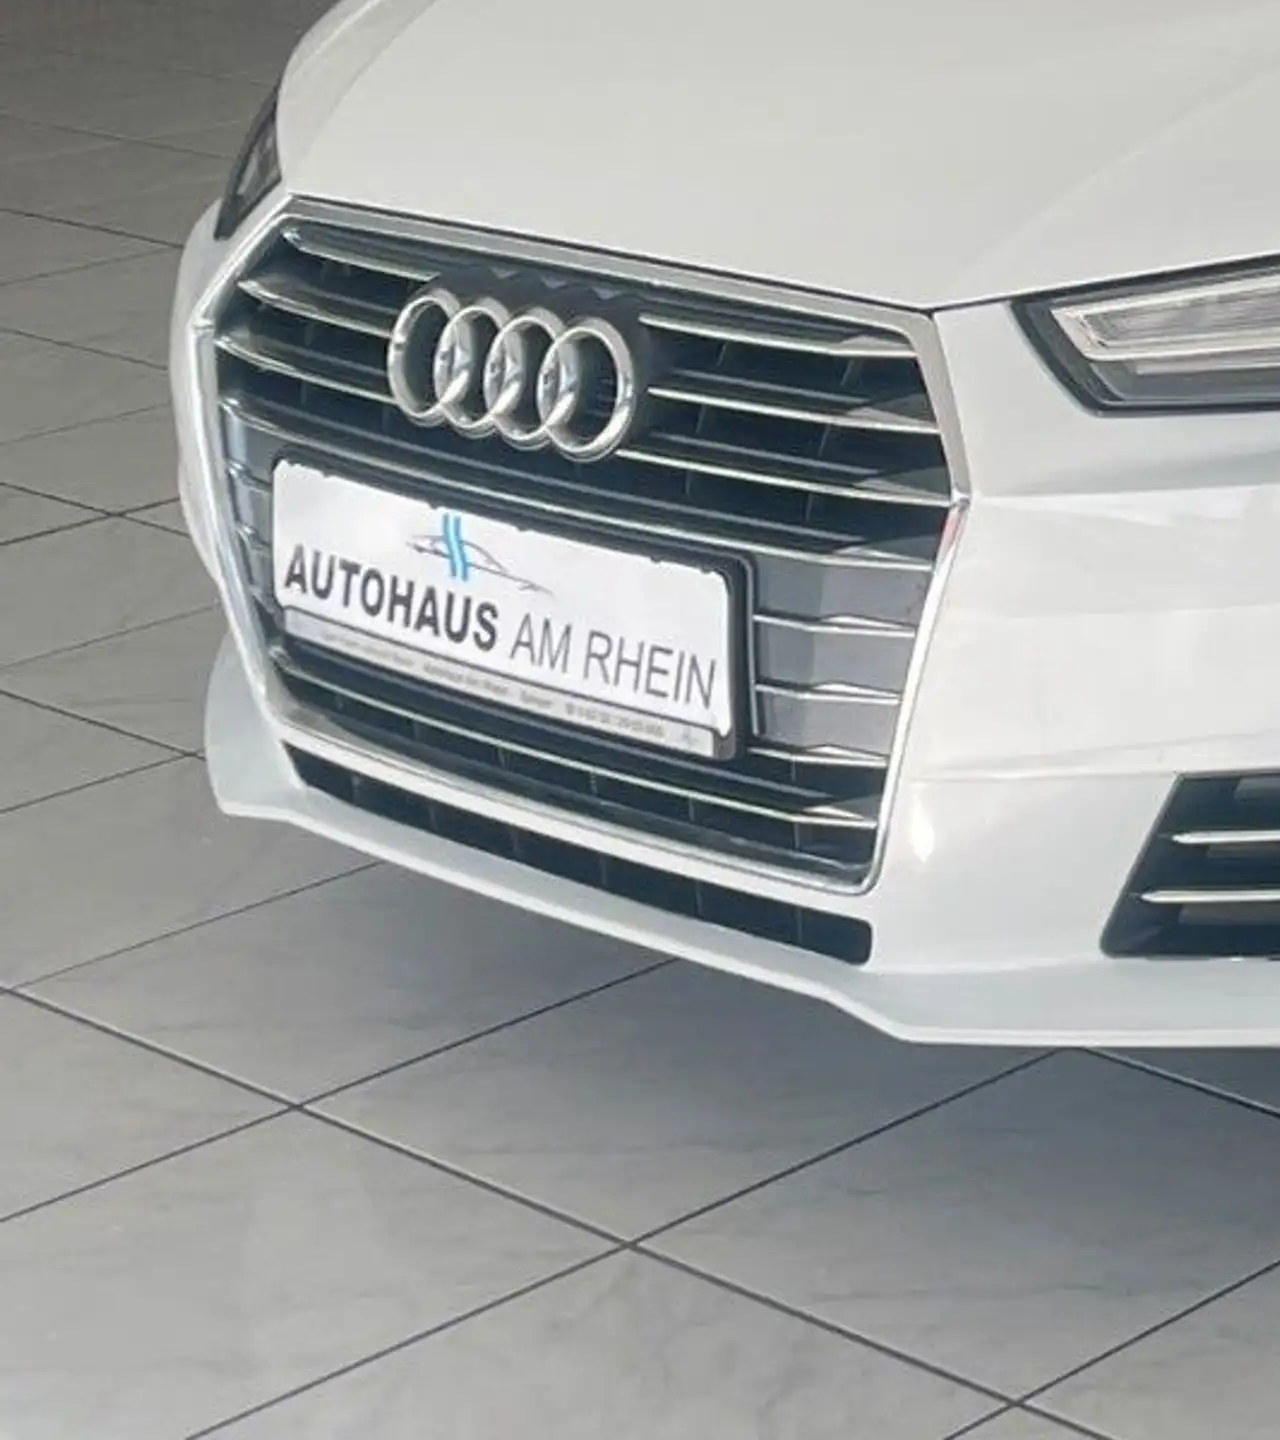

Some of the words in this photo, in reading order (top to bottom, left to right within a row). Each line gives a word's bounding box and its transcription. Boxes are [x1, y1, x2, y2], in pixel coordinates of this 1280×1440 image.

[284, 544, 499, 652] AUTOHAUS
[510, 613, 572, 673] AM
[583, 629, 716, 709] RHEIN
